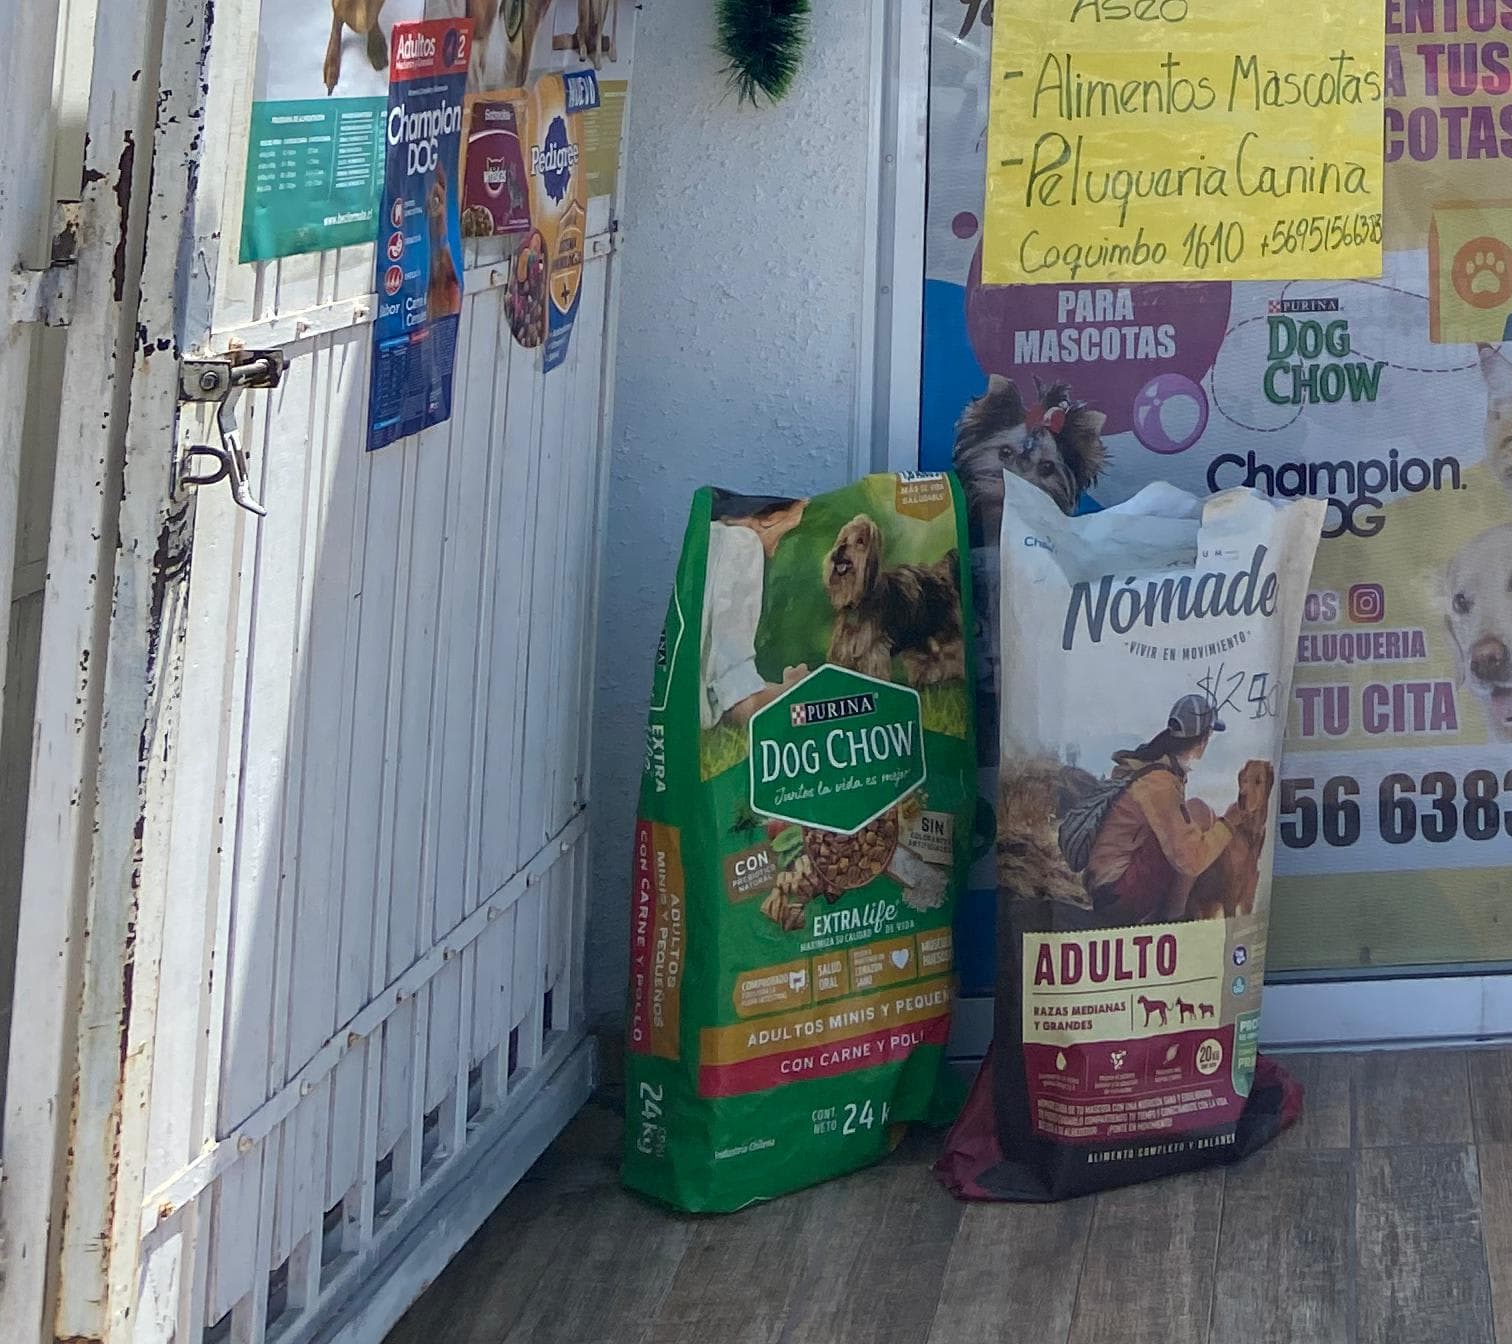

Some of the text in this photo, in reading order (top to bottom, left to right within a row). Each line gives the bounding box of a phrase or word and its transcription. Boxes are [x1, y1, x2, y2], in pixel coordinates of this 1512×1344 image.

[396, 33, 466, 61] Adultos 2
[1227, 49, 1383, 112] Mascotas
[1417, 42, 1511, 96] TUS
[388, 100, 462, 146] Champion
[407, 138, 438, 176] DOG
[530, 142, 580, 176] Pedigree
[1235, 131, 1371, 199] Canina
[1019, 227, 1168, 279] Coquimbo
[1057, 288, 1135, 324] PARA
[1283, 300, 1337, 311] PURINA
[1014, 323, 1177, 365] MASCOTAS
[1267, 314, 1350, 361] DOG
[1263, 360, 1386, 405] CHOW
[1062, 544, 1278, 651] Nómade
[1163, 649, 1176, 661] EN
[807, 696, 873, 721] PURINA
[1296, 681, 1458, 737] TU CITA
[651, 724, 667, 793] EXTRA
[760, 720, 913, 783] DOG CHOW
[774, 768, 911, 806] Juntos la vida es mejor
[921, 817, 944, 835] SIN
[639, 829, 648, 871] CON
[735, 851, 768, 876] CON
[637, 878, 650, 948] CARNE
[667, 893, 681, 989] ADULTOS
[800, 938, 834, 953] MAXIMIZA
[835, 936, 844, 946] SU
[844, 929, 873, 944] CALIDAD
[1034, 933, 1178, 986] ADULTO
[817, 961, 842, 976] SALUD
[818, 976, 839, 991] ORAL
[633, 974, 644, 1042] POLLO
[747, 1018, 824, 1047] ADULTOS
[829, 1006, 875, 1030] MINIS
[880, 1001, 890, 1016] Y
[1033, 1001, 1126, 1017] RAZAS MEDIANAS
[1034, 1020, 1093, 1031] Y GRANDES
[780, 1055, 814, 1074] CON
[819, 1043, 871, 1067] CARNE
[876, 1039, 885, 1053] Y
[1200, 1045, 1212, 1062] 20
[813, 1120, 837, 1135] NETO
[842, 1098, 874, 1136] 24
[1087, 1148, 1134, 1163] ALIMENTO
[1138, 1144, 1185, 1158] COMPLETO
[1188, 1141, 1194, 1151] Y
